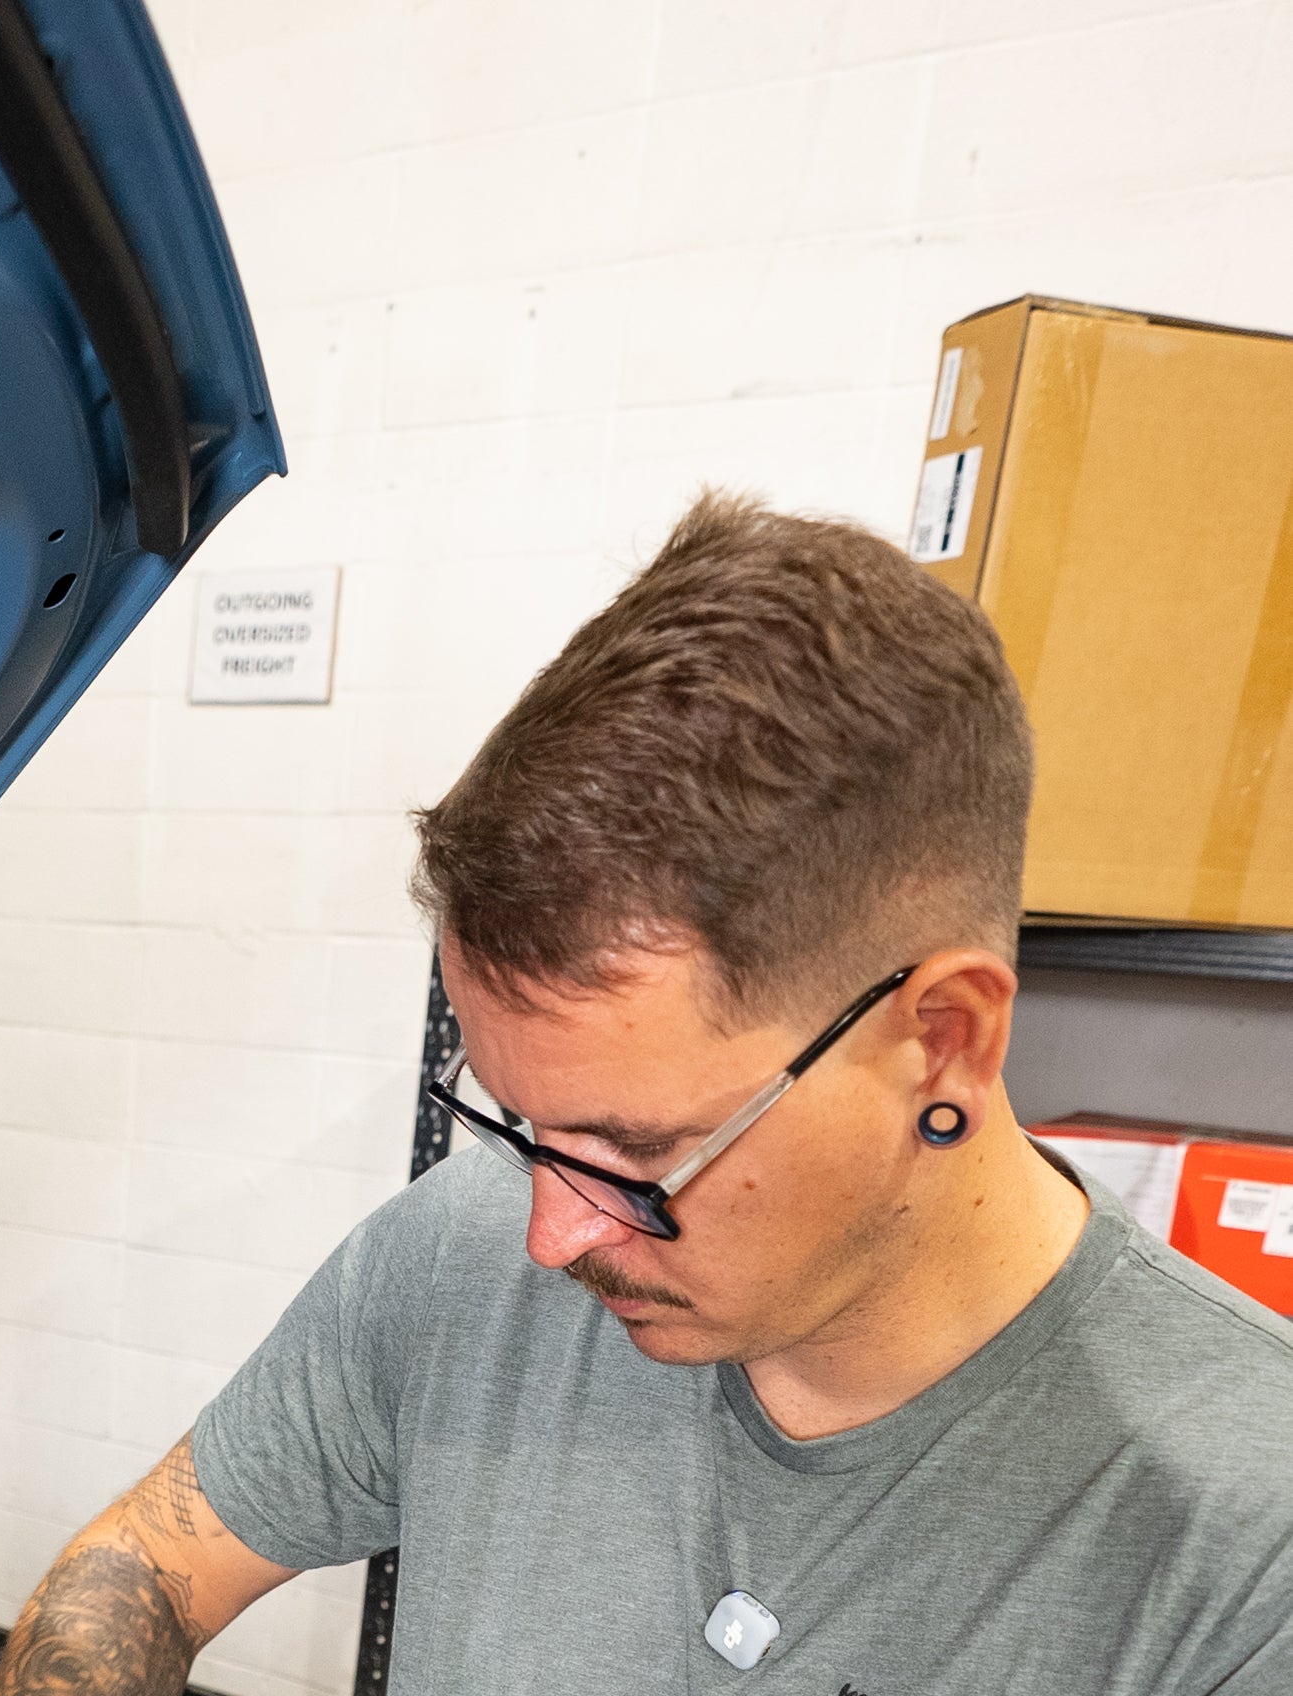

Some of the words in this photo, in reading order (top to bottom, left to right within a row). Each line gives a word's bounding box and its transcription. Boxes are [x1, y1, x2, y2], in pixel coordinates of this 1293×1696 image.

[214, 591, 312, 612] OUTGOING
[213, 625, 310, 644] OVERSIZED
[221, 656, 295, 675] FREIGHT
